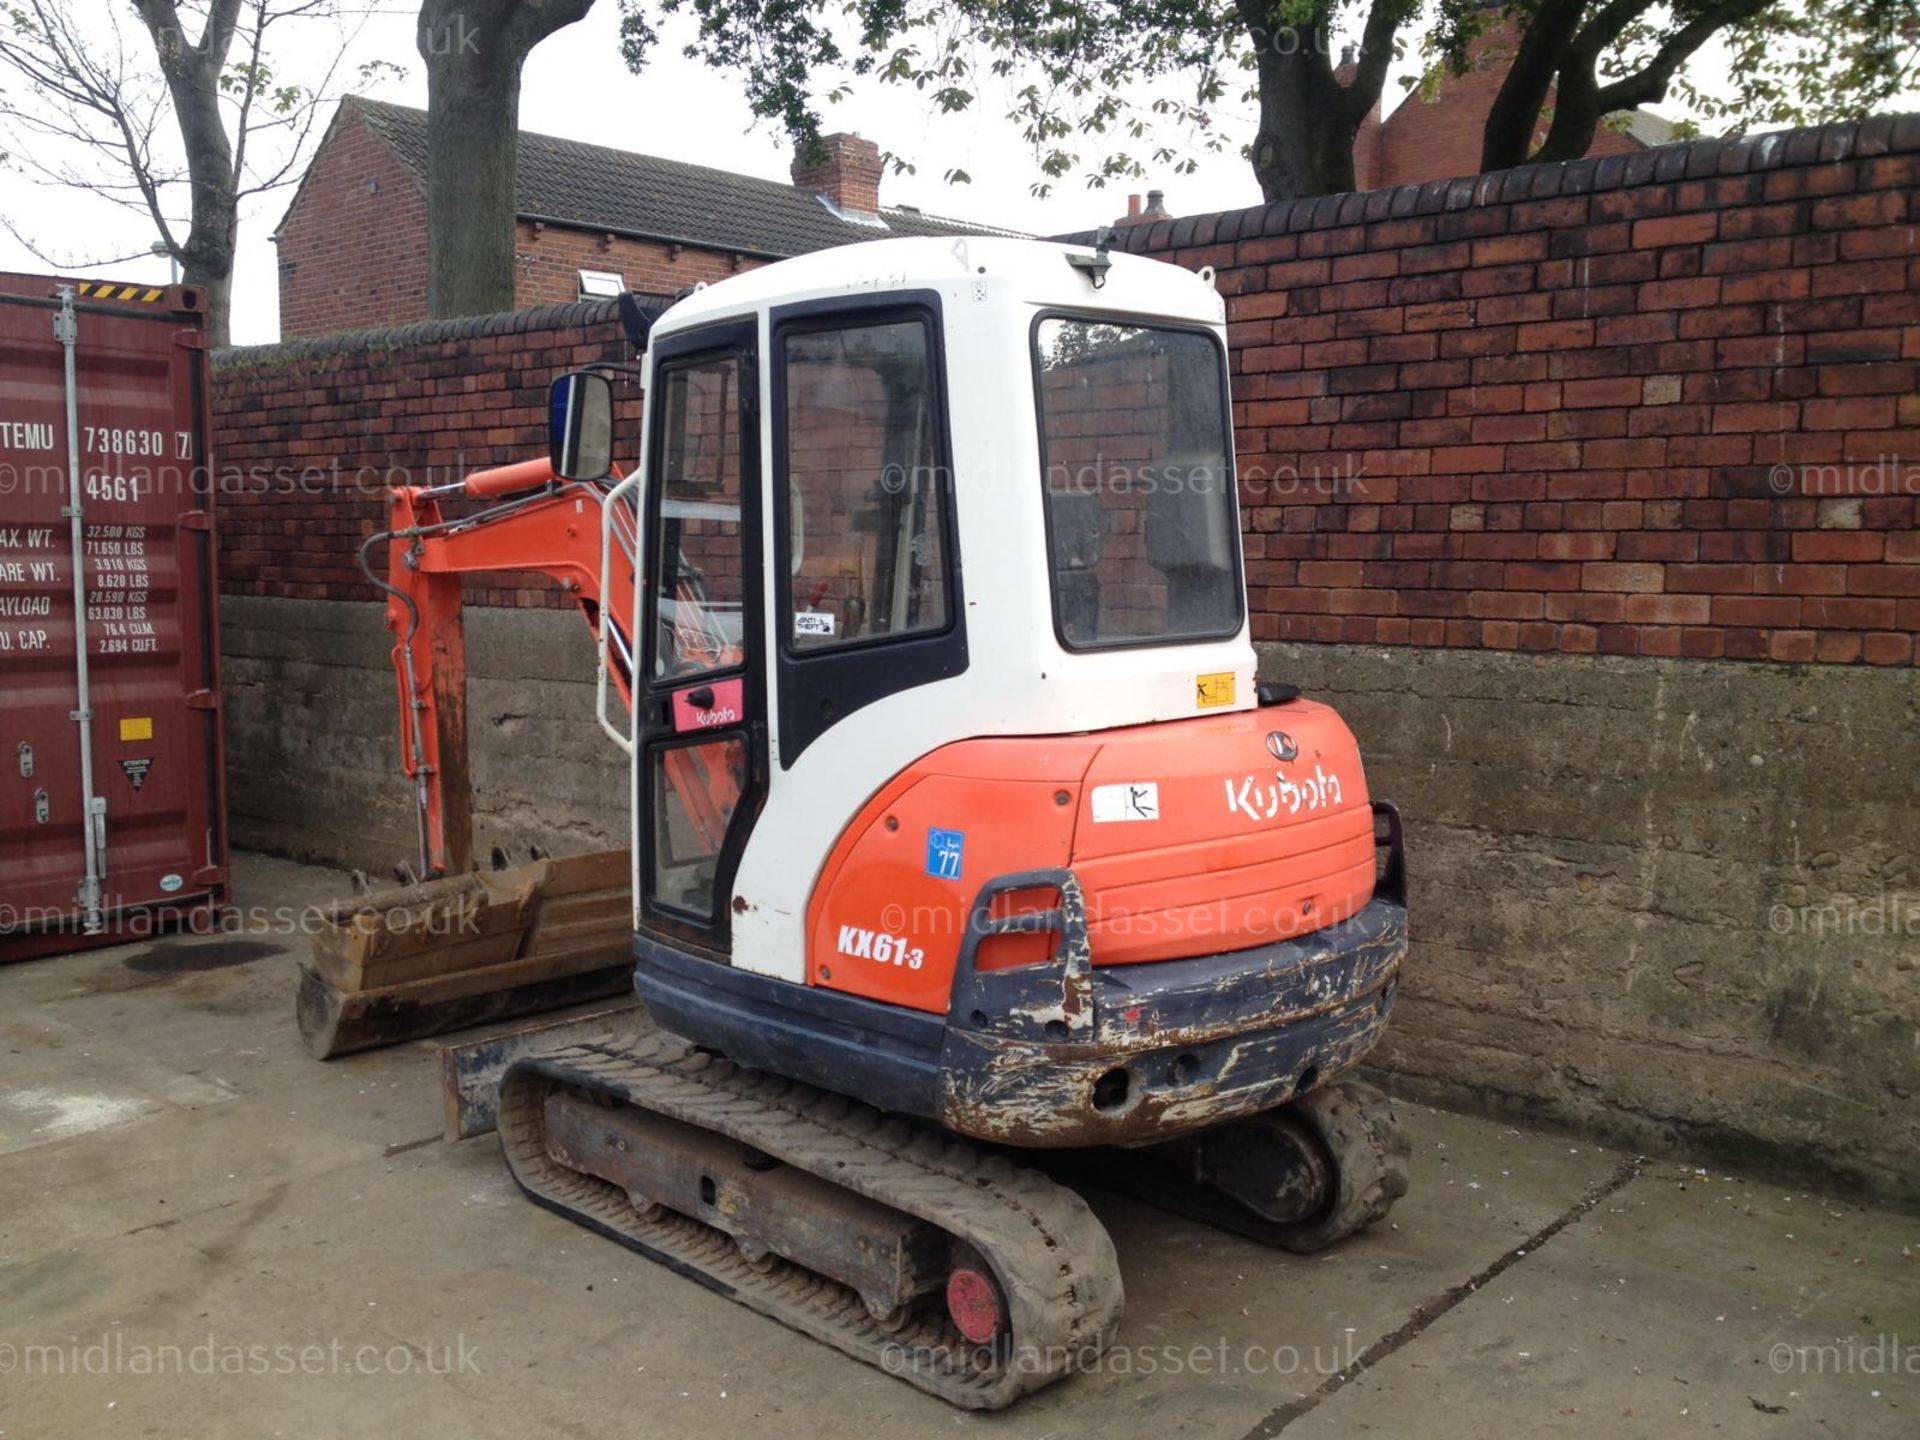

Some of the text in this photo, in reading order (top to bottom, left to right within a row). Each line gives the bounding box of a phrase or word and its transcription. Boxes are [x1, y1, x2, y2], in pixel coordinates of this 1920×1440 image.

[0, 422, 190, 459] TEMU 738630 7
[87, 475, 138, 502] 45G1
[27, 528, 55, 548] WT.
[124, 541, 144, 555] LBS
[30, 563, 60, 581] WT.
[126, 559, 148, 571] KGS
[129, 574, 149, 588] LBS
[126, 606, 146, 619] LBS
[19, 630, 50, 649] CAP.
[696, 706, 736, 725] Kubota
[1225, 765, 1342, 821] Kubota
[938, 850, 960, 876] 77
[837, 925, 924, 970] KX61-3
